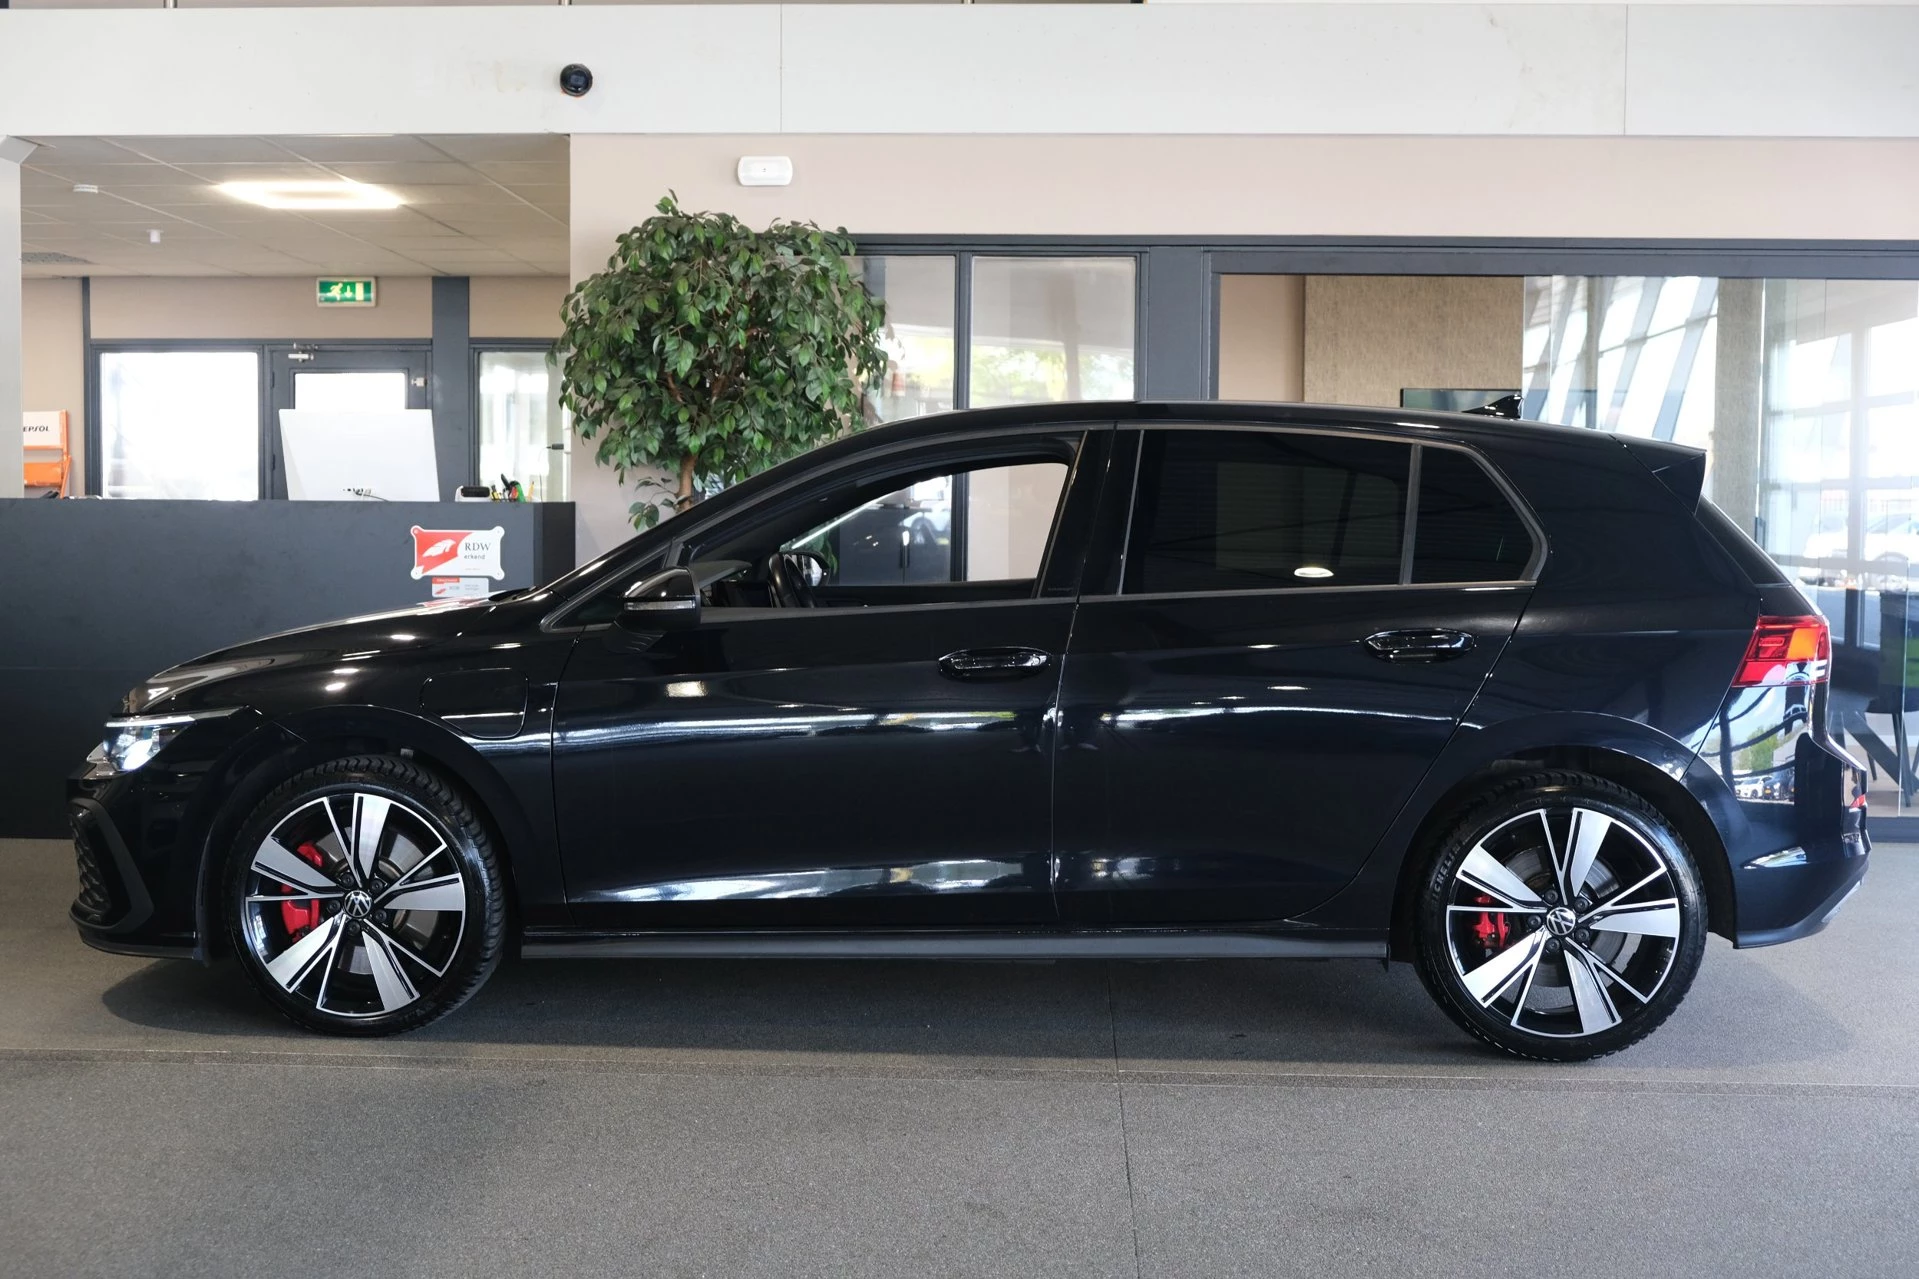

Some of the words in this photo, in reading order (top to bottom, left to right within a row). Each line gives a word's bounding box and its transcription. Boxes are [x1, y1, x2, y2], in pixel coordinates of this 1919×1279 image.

[22, 425, 50, 433] EPSOL
[464, 542, 491, 551] RDW
[1430, 843, 1461, 906] ICHELIN
